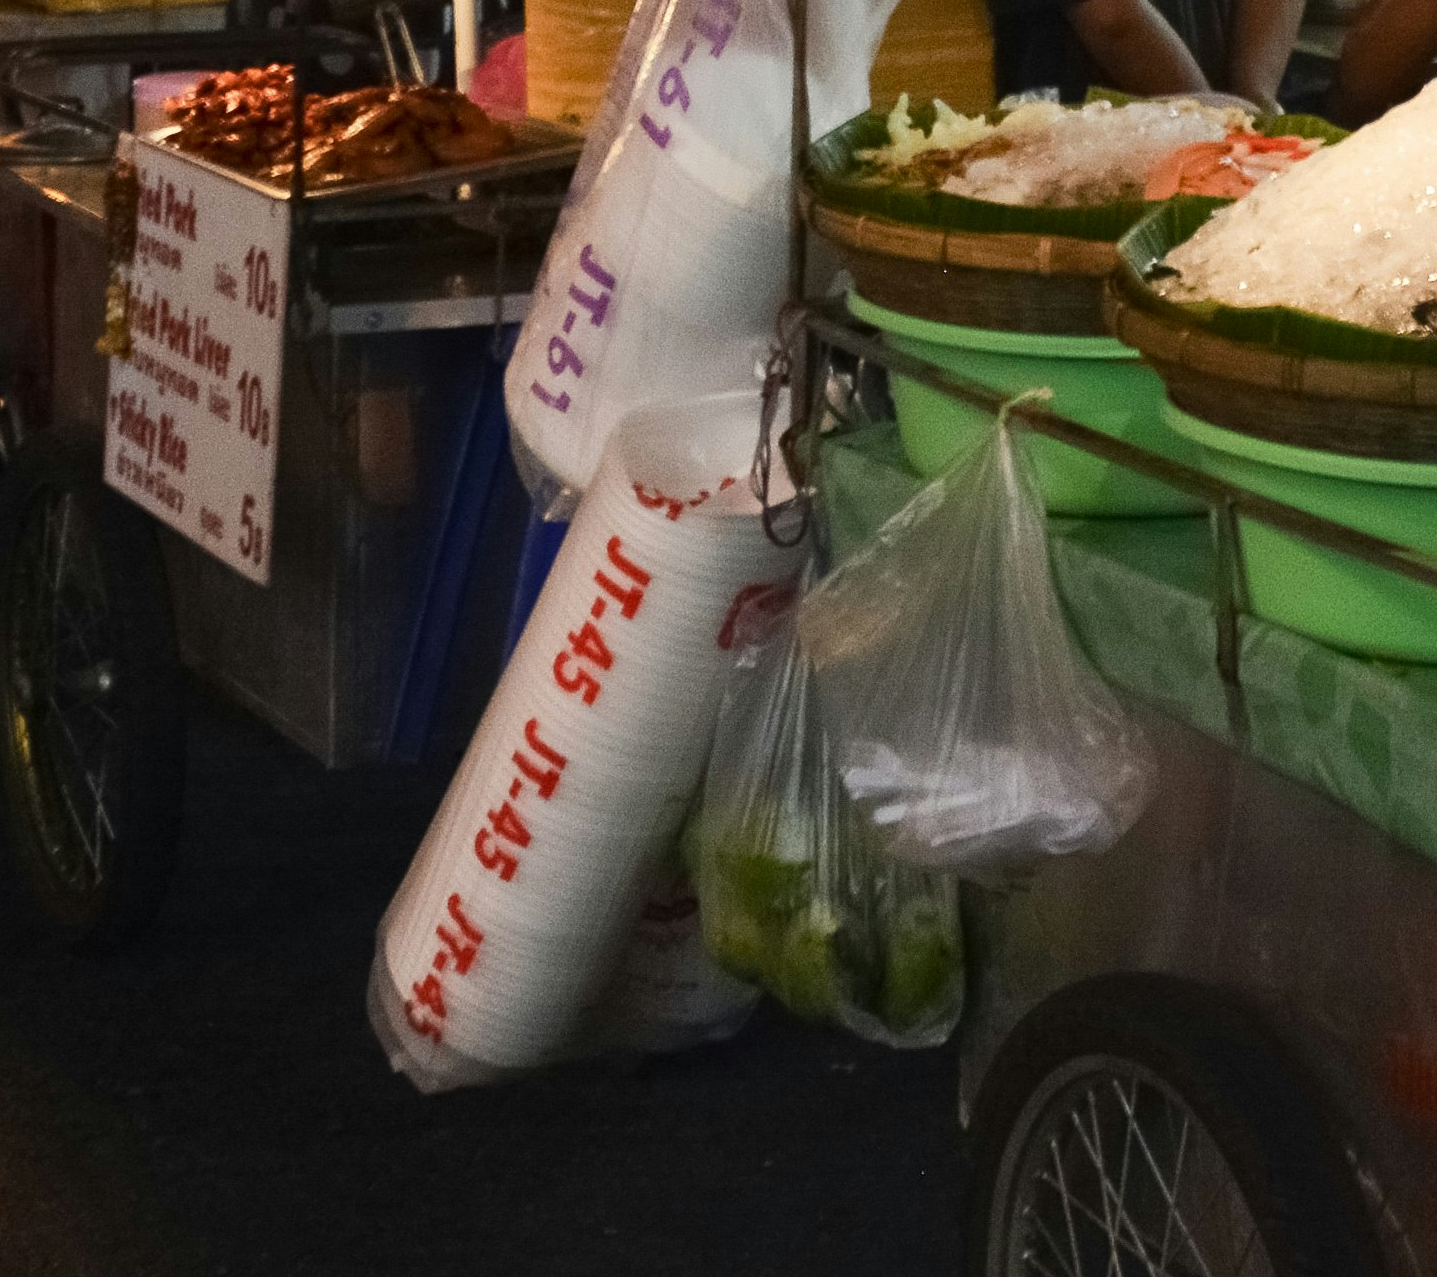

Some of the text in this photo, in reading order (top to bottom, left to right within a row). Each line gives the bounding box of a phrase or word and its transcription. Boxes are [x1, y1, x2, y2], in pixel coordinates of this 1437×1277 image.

[164, 181, 198, 242] Pork
[159, 295, 192, 359] Pork
[193, 316, 231, 379] Liver
[530, 244, 617, 414] JT-61
[118, 389, 188, 474] Sticky Rice
[552, 535, 652, 707] JT-45
[474, 717, 567, 883] JT-45
[405, 893, 484, 1045] JT-45
